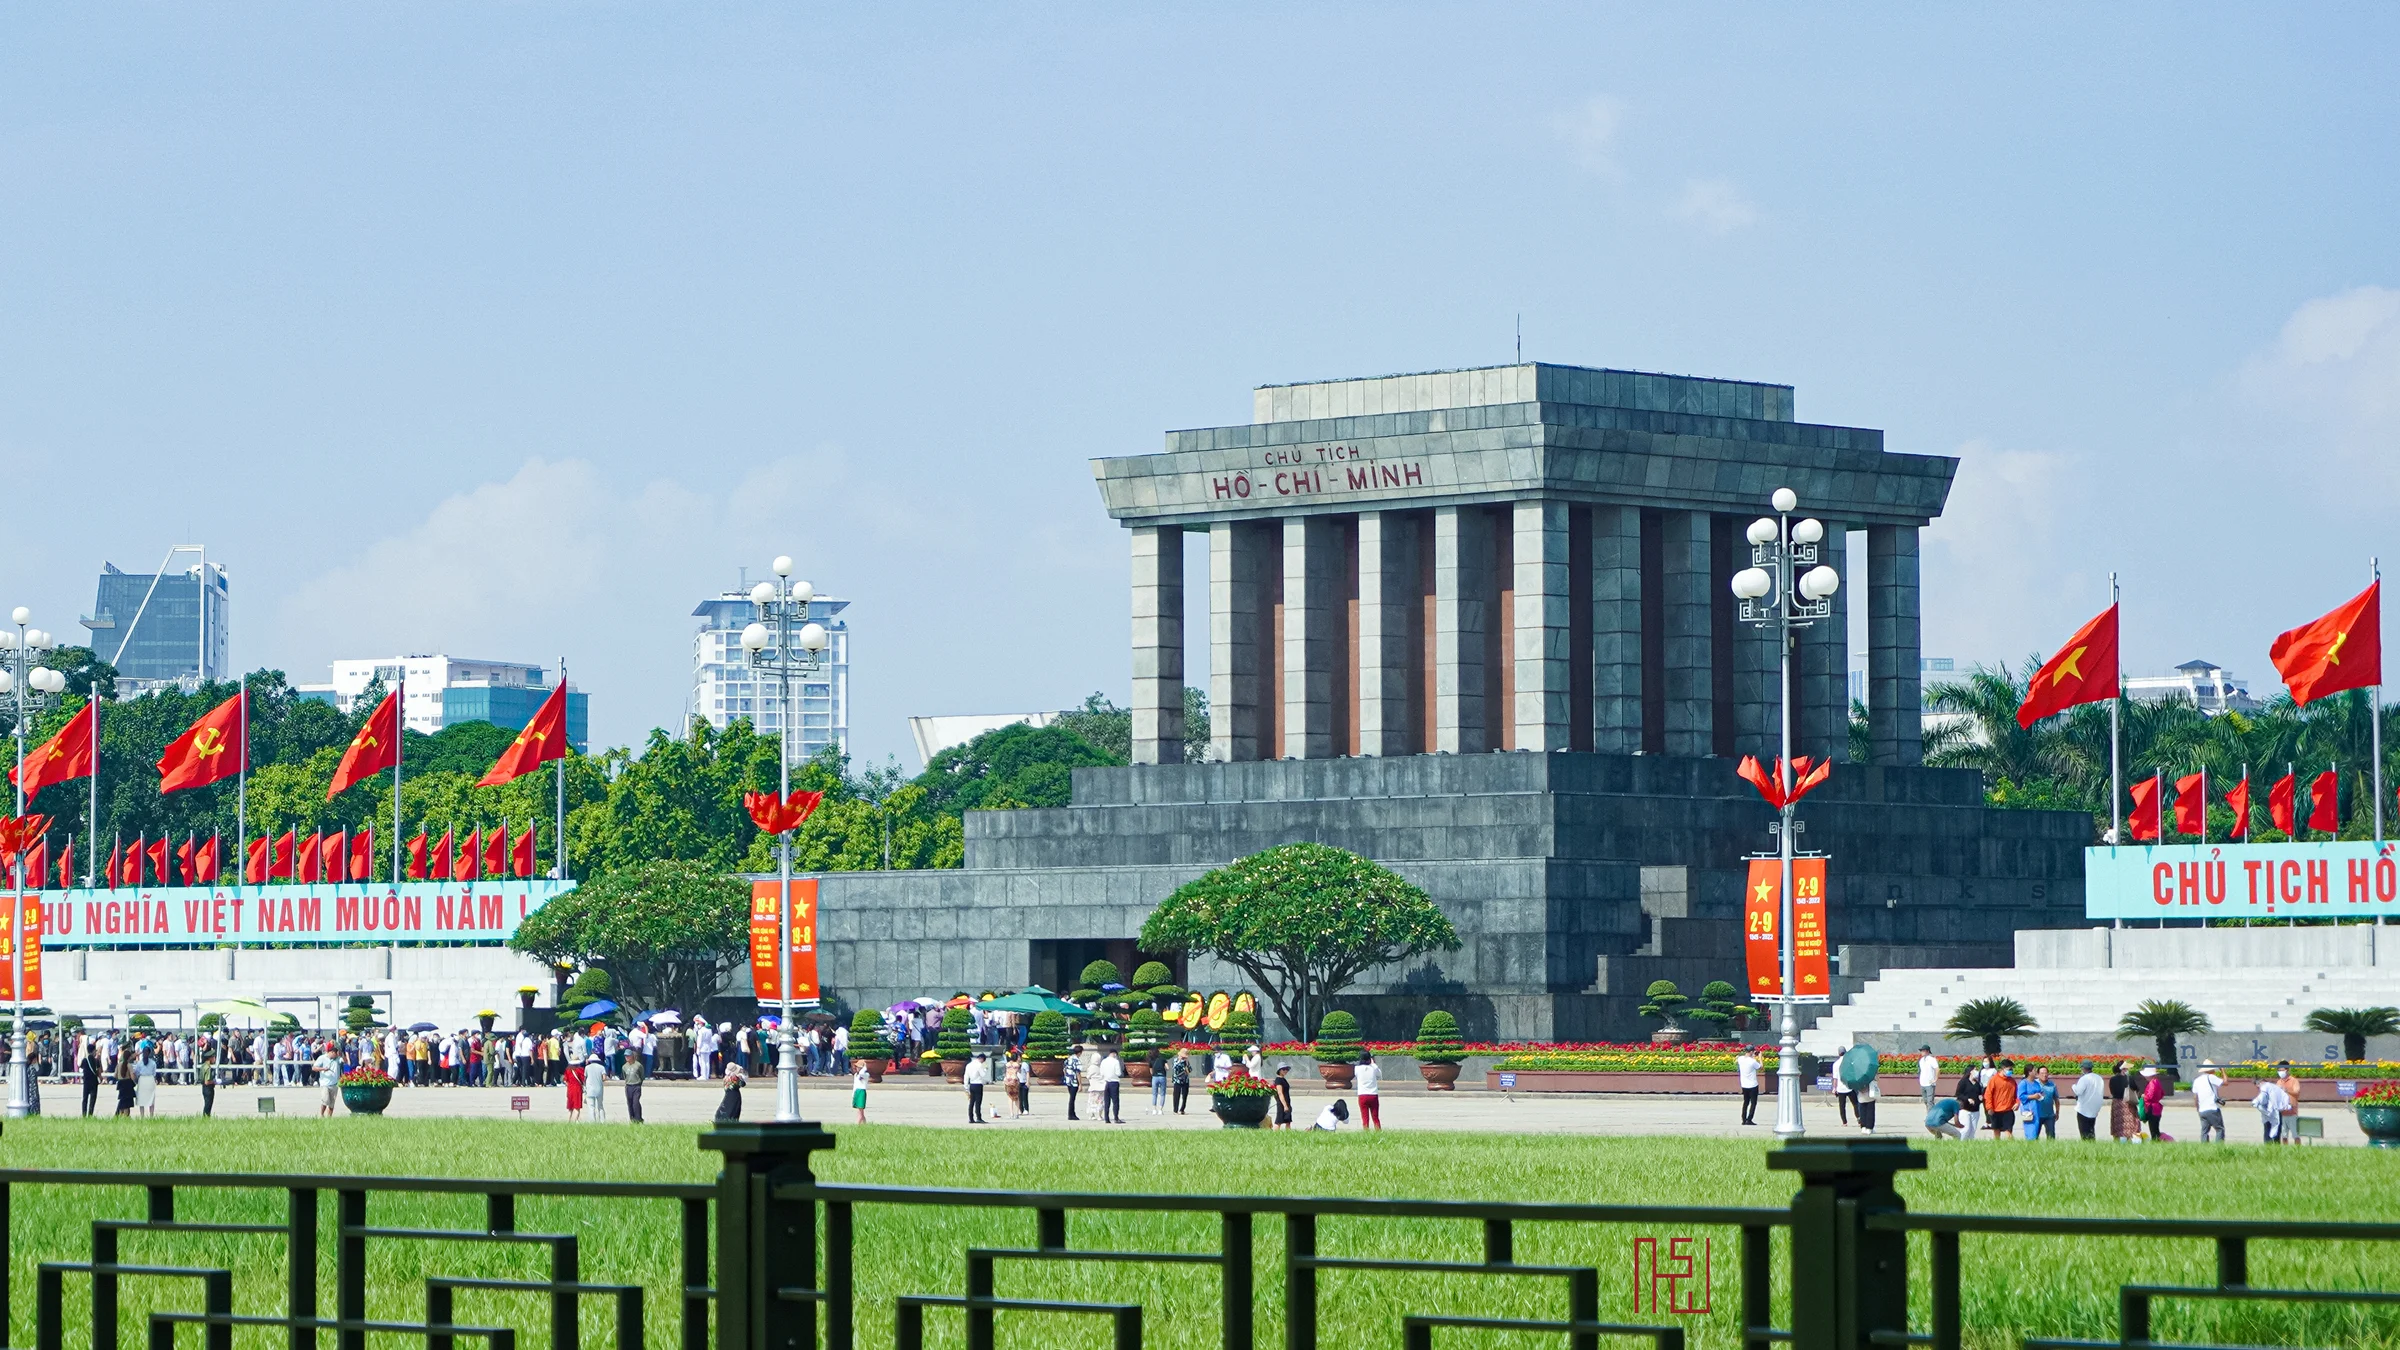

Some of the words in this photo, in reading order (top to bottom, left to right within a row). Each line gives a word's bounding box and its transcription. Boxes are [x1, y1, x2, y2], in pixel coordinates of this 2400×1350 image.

[1265, 444, 1301, 466] CHỦ
[1797, 876, 1819, 897] 2-9
[2153, 847, 2226, 905] CHỦ
[2243, 859, 2329, 913] TỊCH
[2347, 843, 2397, 903] HỒ
[85, 894, 170, 935] NGHĨA
[184, 892, 245, 940] VIỆT
[258, 897, 321, 932] NAM
[335, 890, 421, 931] MUÔN
[436, 887, 503, 930] NĂM
[1749, 911, 1773, 932] 2-9
